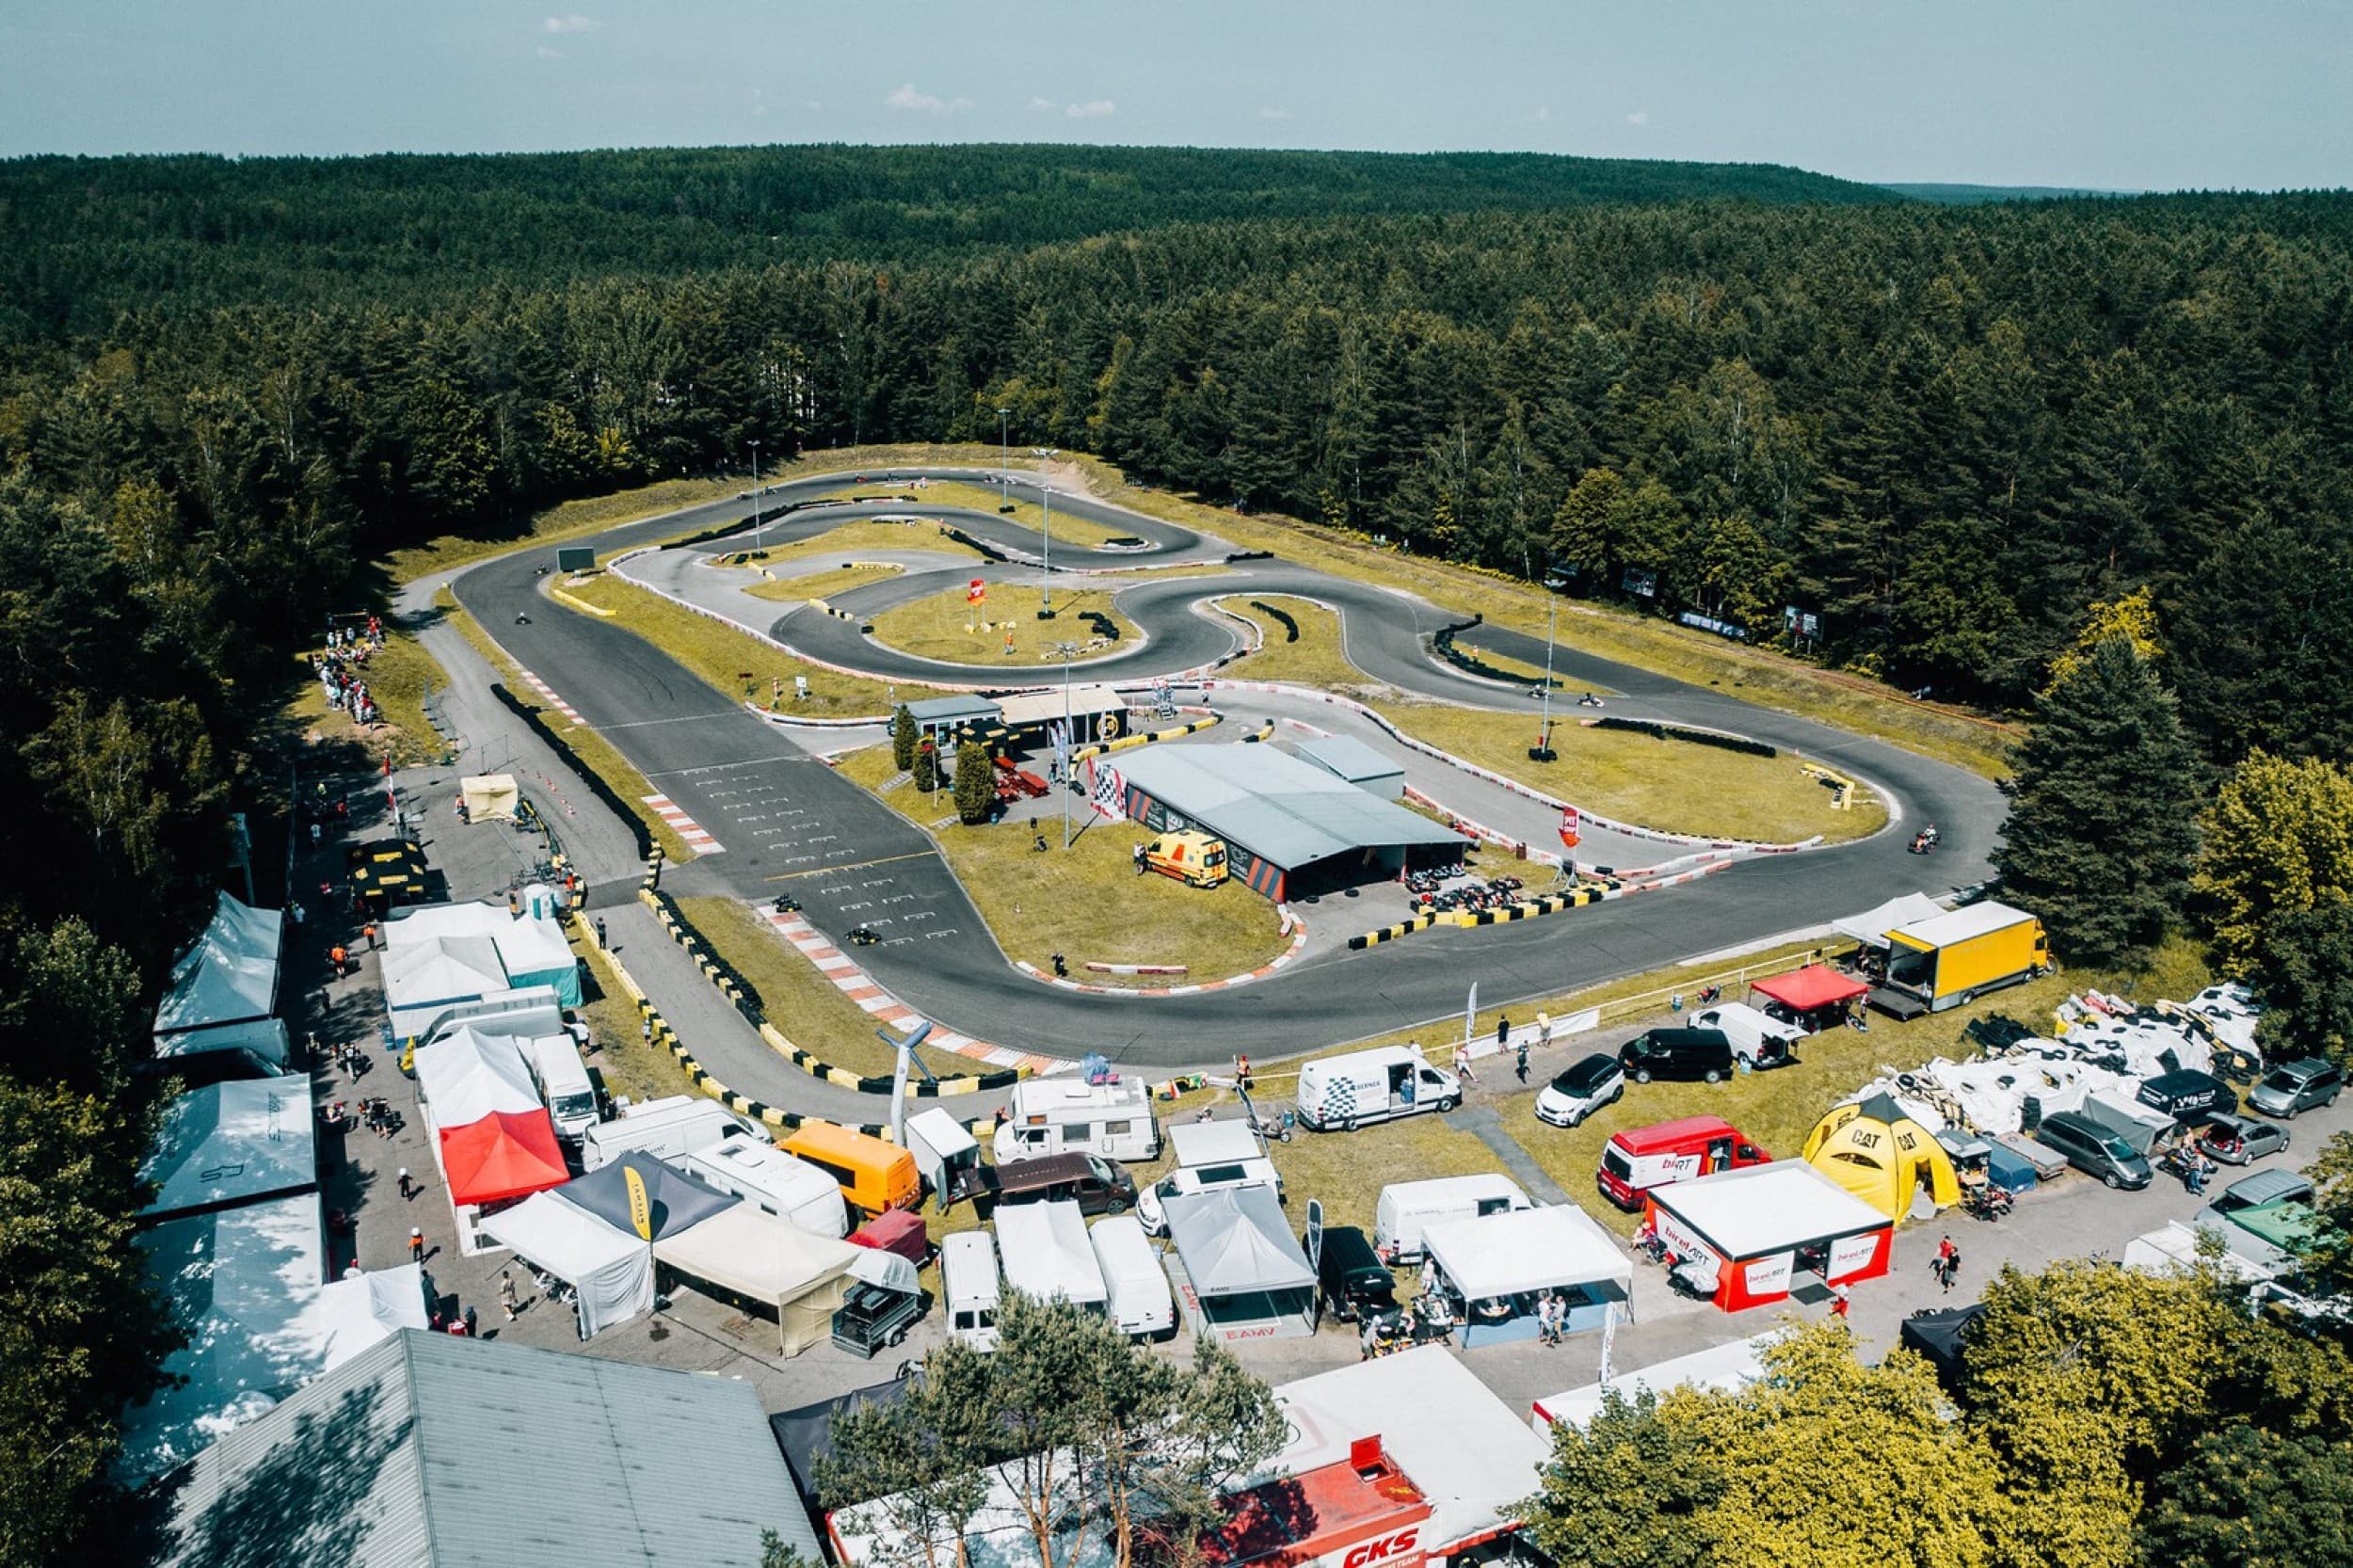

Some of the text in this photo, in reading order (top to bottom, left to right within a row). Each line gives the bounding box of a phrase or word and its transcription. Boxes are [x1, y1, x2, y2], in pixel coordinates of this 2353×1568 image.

[1851, 1129, 1881, 1148] CAT
[1897, 1132, 1916, 1151] CAT
[1343, 1528, 1419, 1568] GKS
